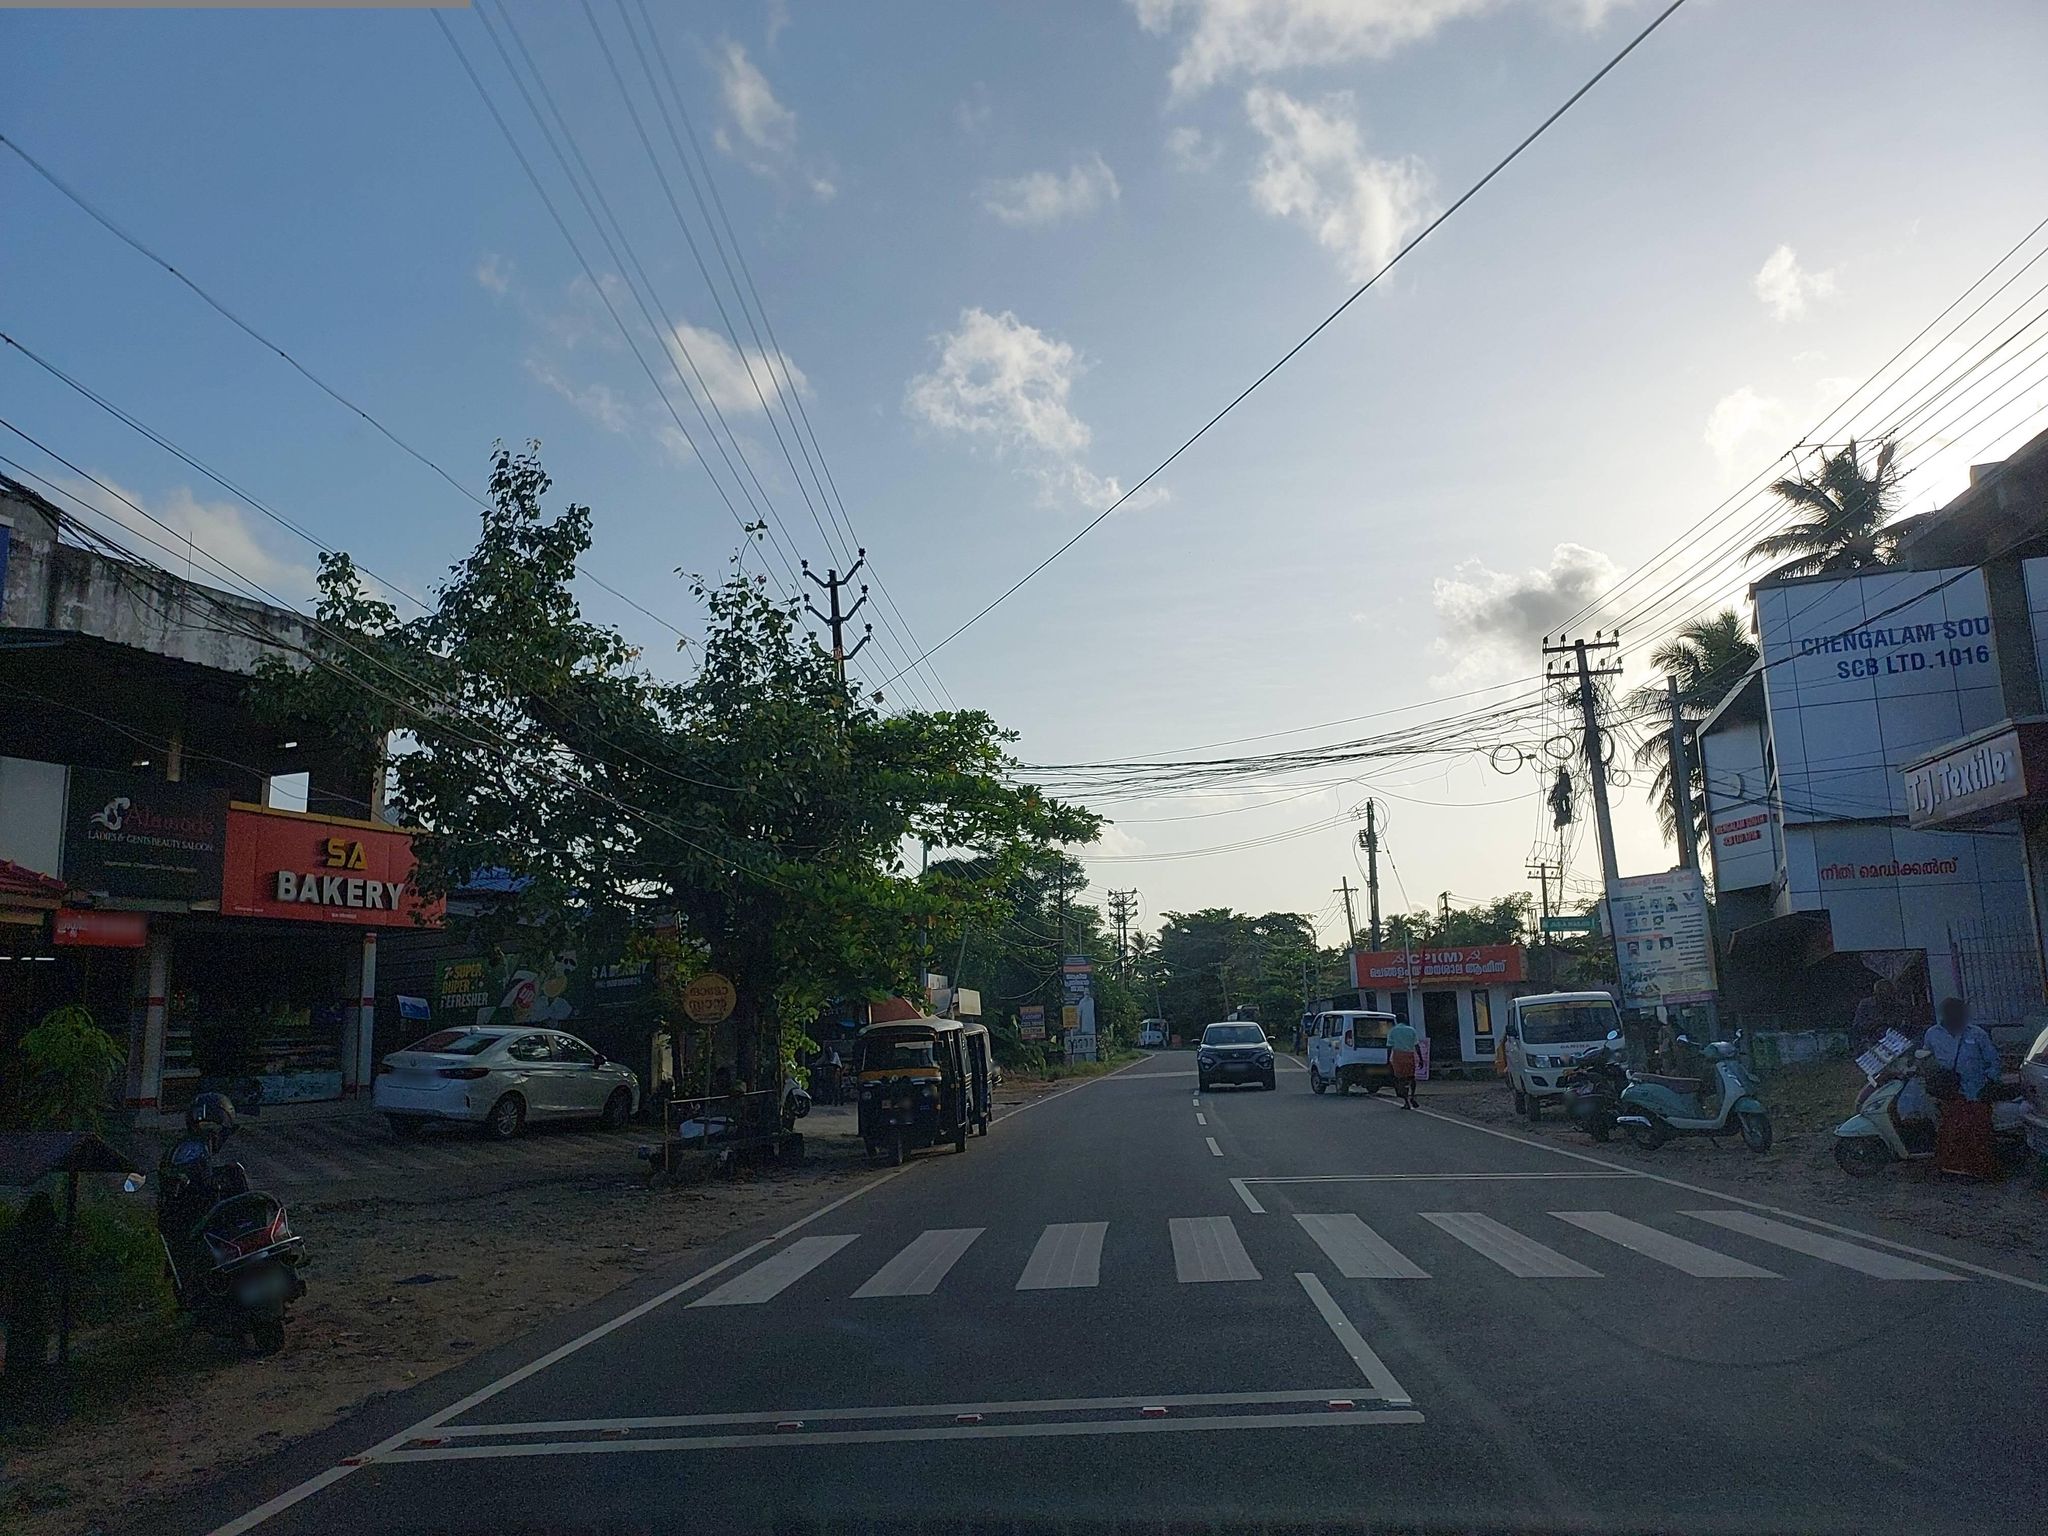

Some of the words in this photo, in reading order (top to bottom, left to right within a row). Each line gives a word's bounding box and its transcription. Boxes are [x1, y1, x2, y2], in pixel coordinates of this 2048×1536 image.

[1801, 624, 1936, 655] CHENGALAM
[1837, 658, 1879, 680] SCB
[126, 834, 151, 845] GENTS
[151, 837, 181, 849] BEAUTY
[327, 837, 369, 870] SA
[278, 870, 405, 911] BAKERY
